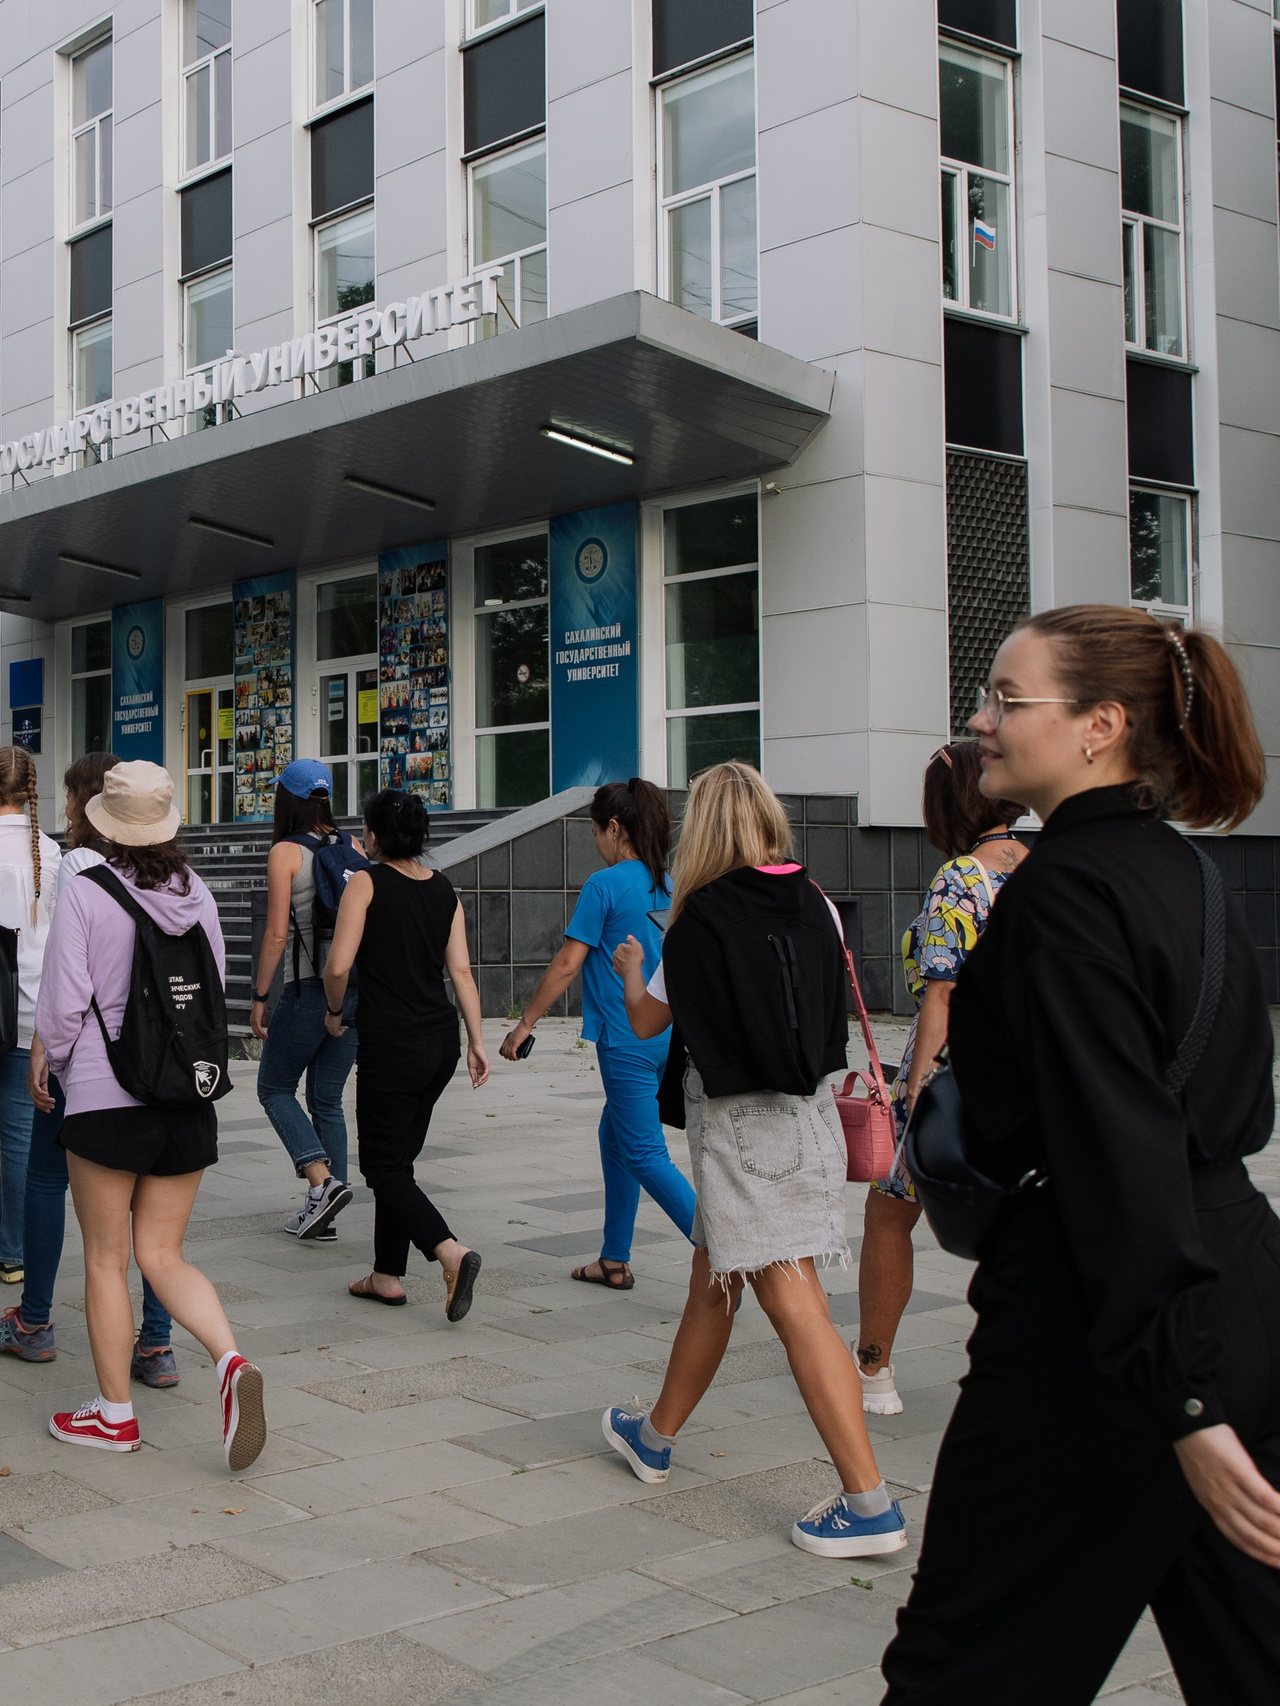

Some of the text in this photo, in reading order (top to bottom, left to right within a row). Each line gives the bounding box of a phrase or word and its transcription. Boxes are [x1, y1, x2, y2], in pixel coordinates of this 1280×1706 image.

[250, 266, 504, 392] УНИВЕРСИТЕТ
[565, 622, 621, 645] САХАЛИНСКИЙ
[556, 640, 631, 665] ГОСУДАРСТВЕННЫЙ
[567, 663, 620, 682] УНИВЕРСИТЕТ
[120, 690, 153, 706] САХАЛИНСКИЙ
[115, 704, 159, 721] ГОСУДАРСТВЕННЫЙ
[121, 721, 153, 735] УНИВЕРСИТЕТ
